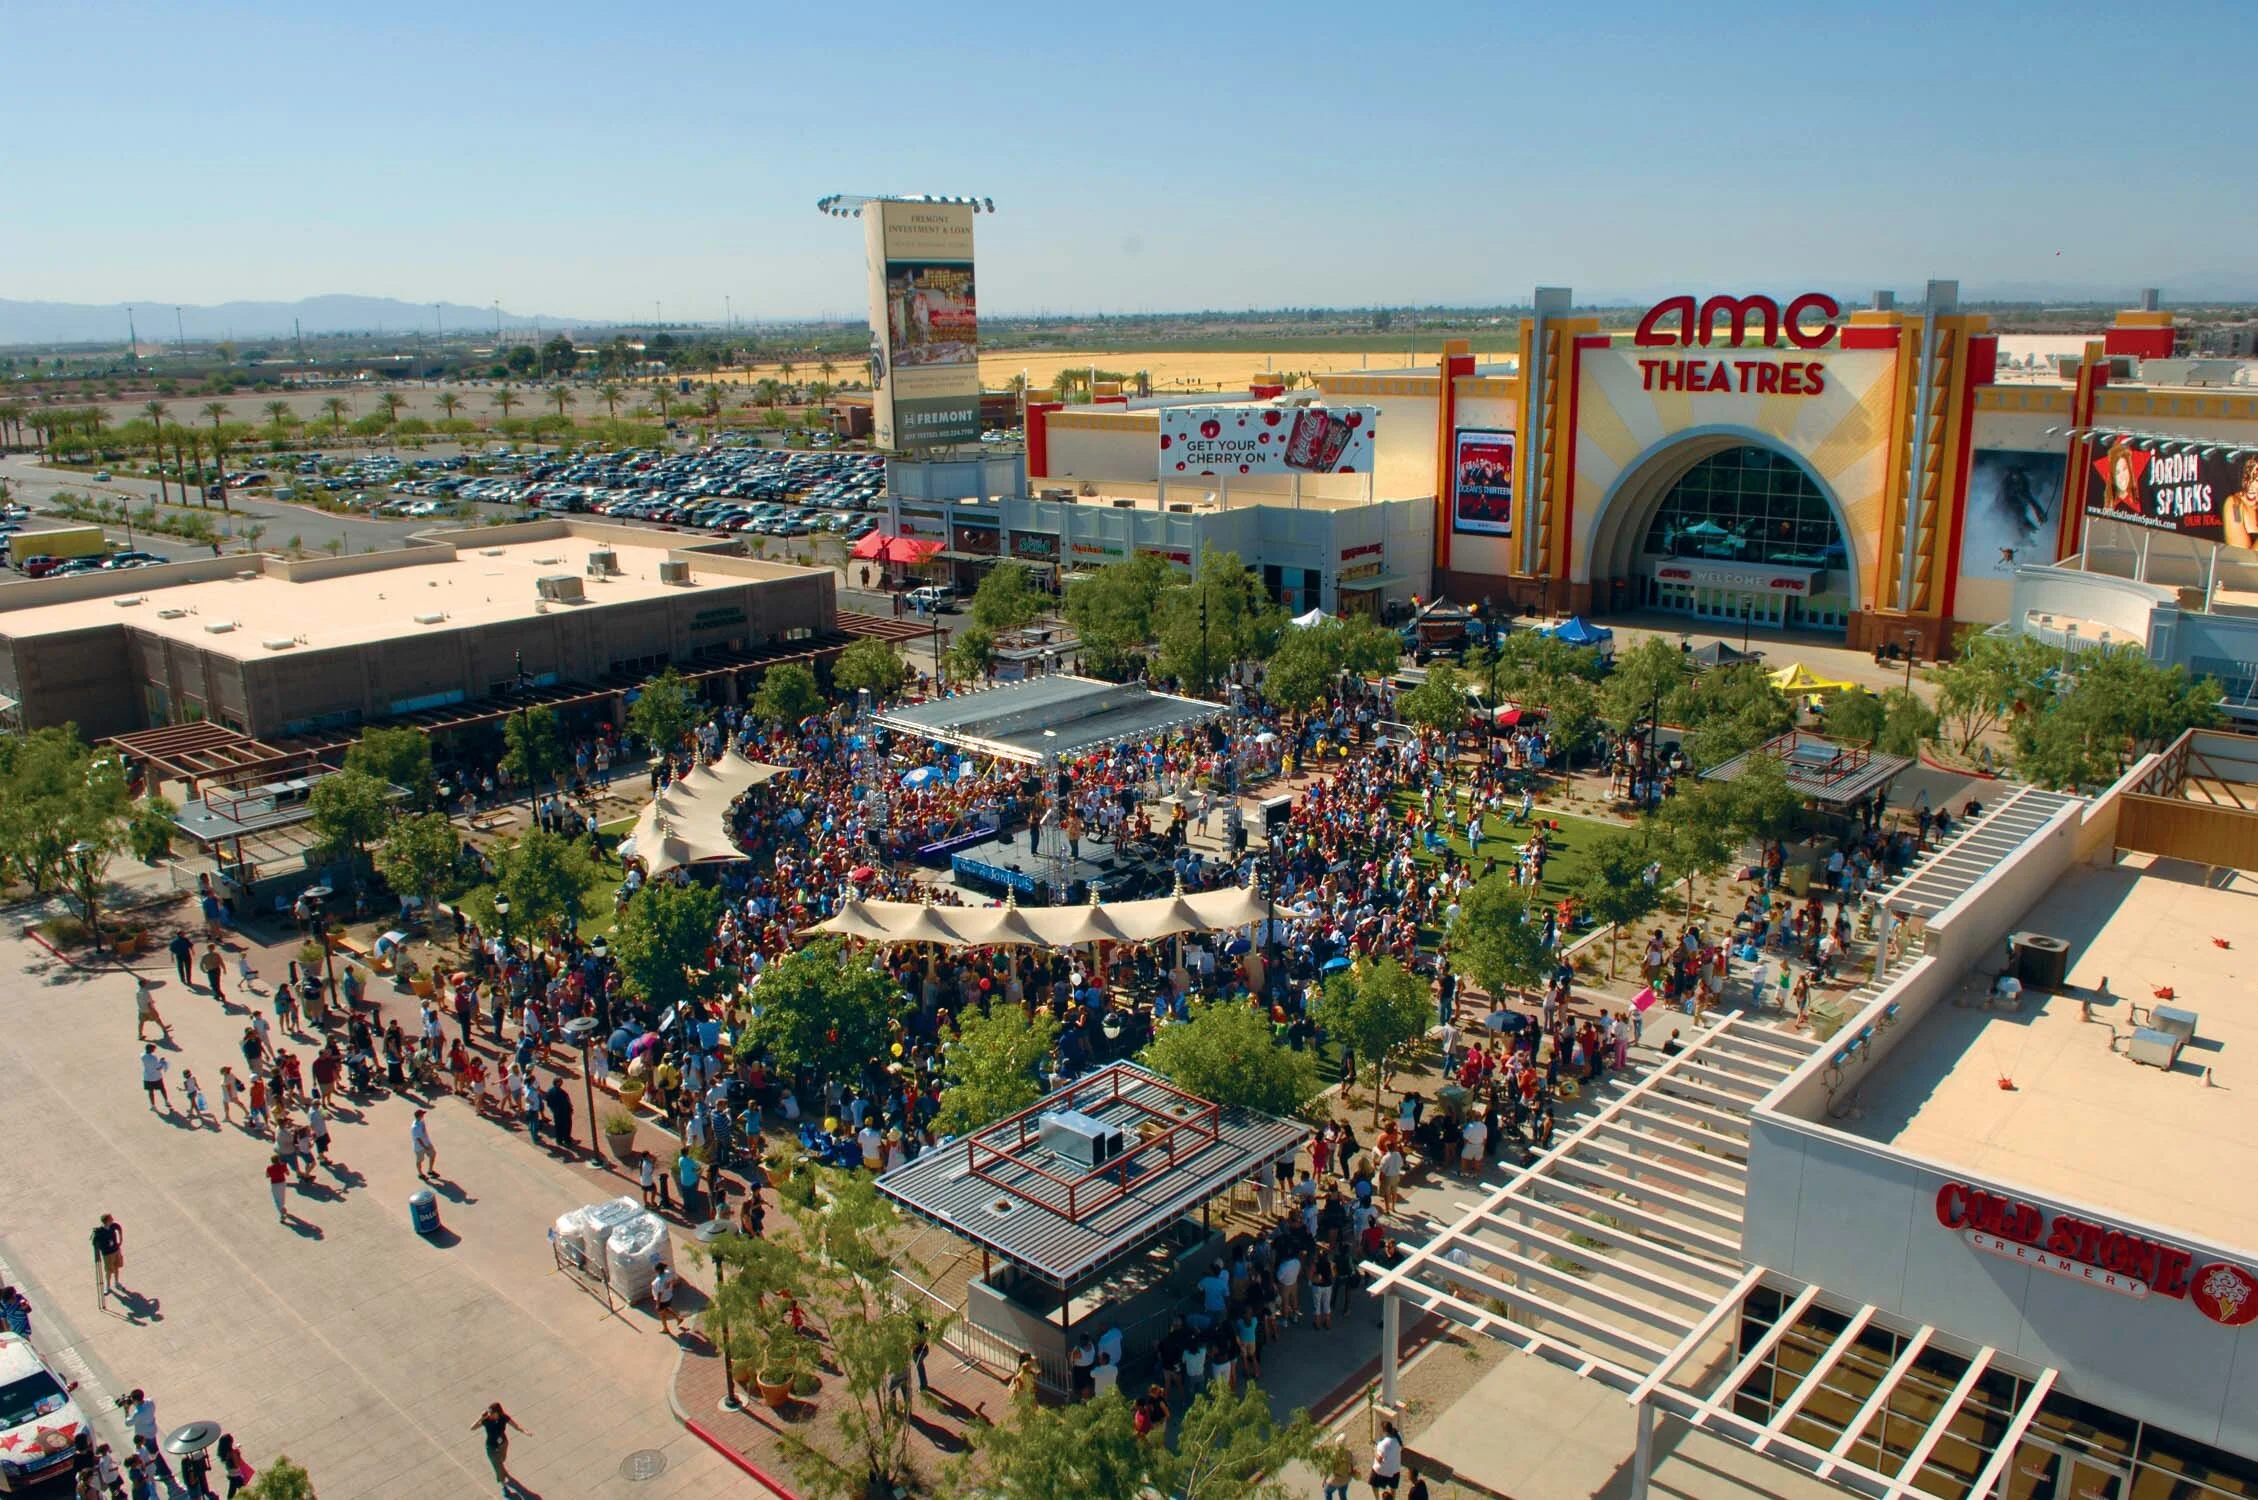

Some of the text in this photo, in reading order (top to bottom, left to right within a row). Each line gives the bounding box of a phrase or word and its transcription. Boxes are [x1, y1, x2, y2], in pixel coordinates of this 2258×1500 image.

[911, 215, 949, 223] FREMONT
[888, 224, 940, 233] INVESTMENT
[950, 226, 970, 234] LOAN
[1638, 360, 1825, 395] THEATRES
[917, 410, 973, 425] FREMONT
[1186, 440, 1256, 451] GET YOUR
[1186, 452, 1266, 464] CHERRY ON
[2156, 484, 2212, 516] SPARKS
[1695, 570, 1765, 586] WELCOME
[1935, 1181, 2193, 1300] COLD STONE
[1973, 1234, 2138, 1292] CREAMERY
